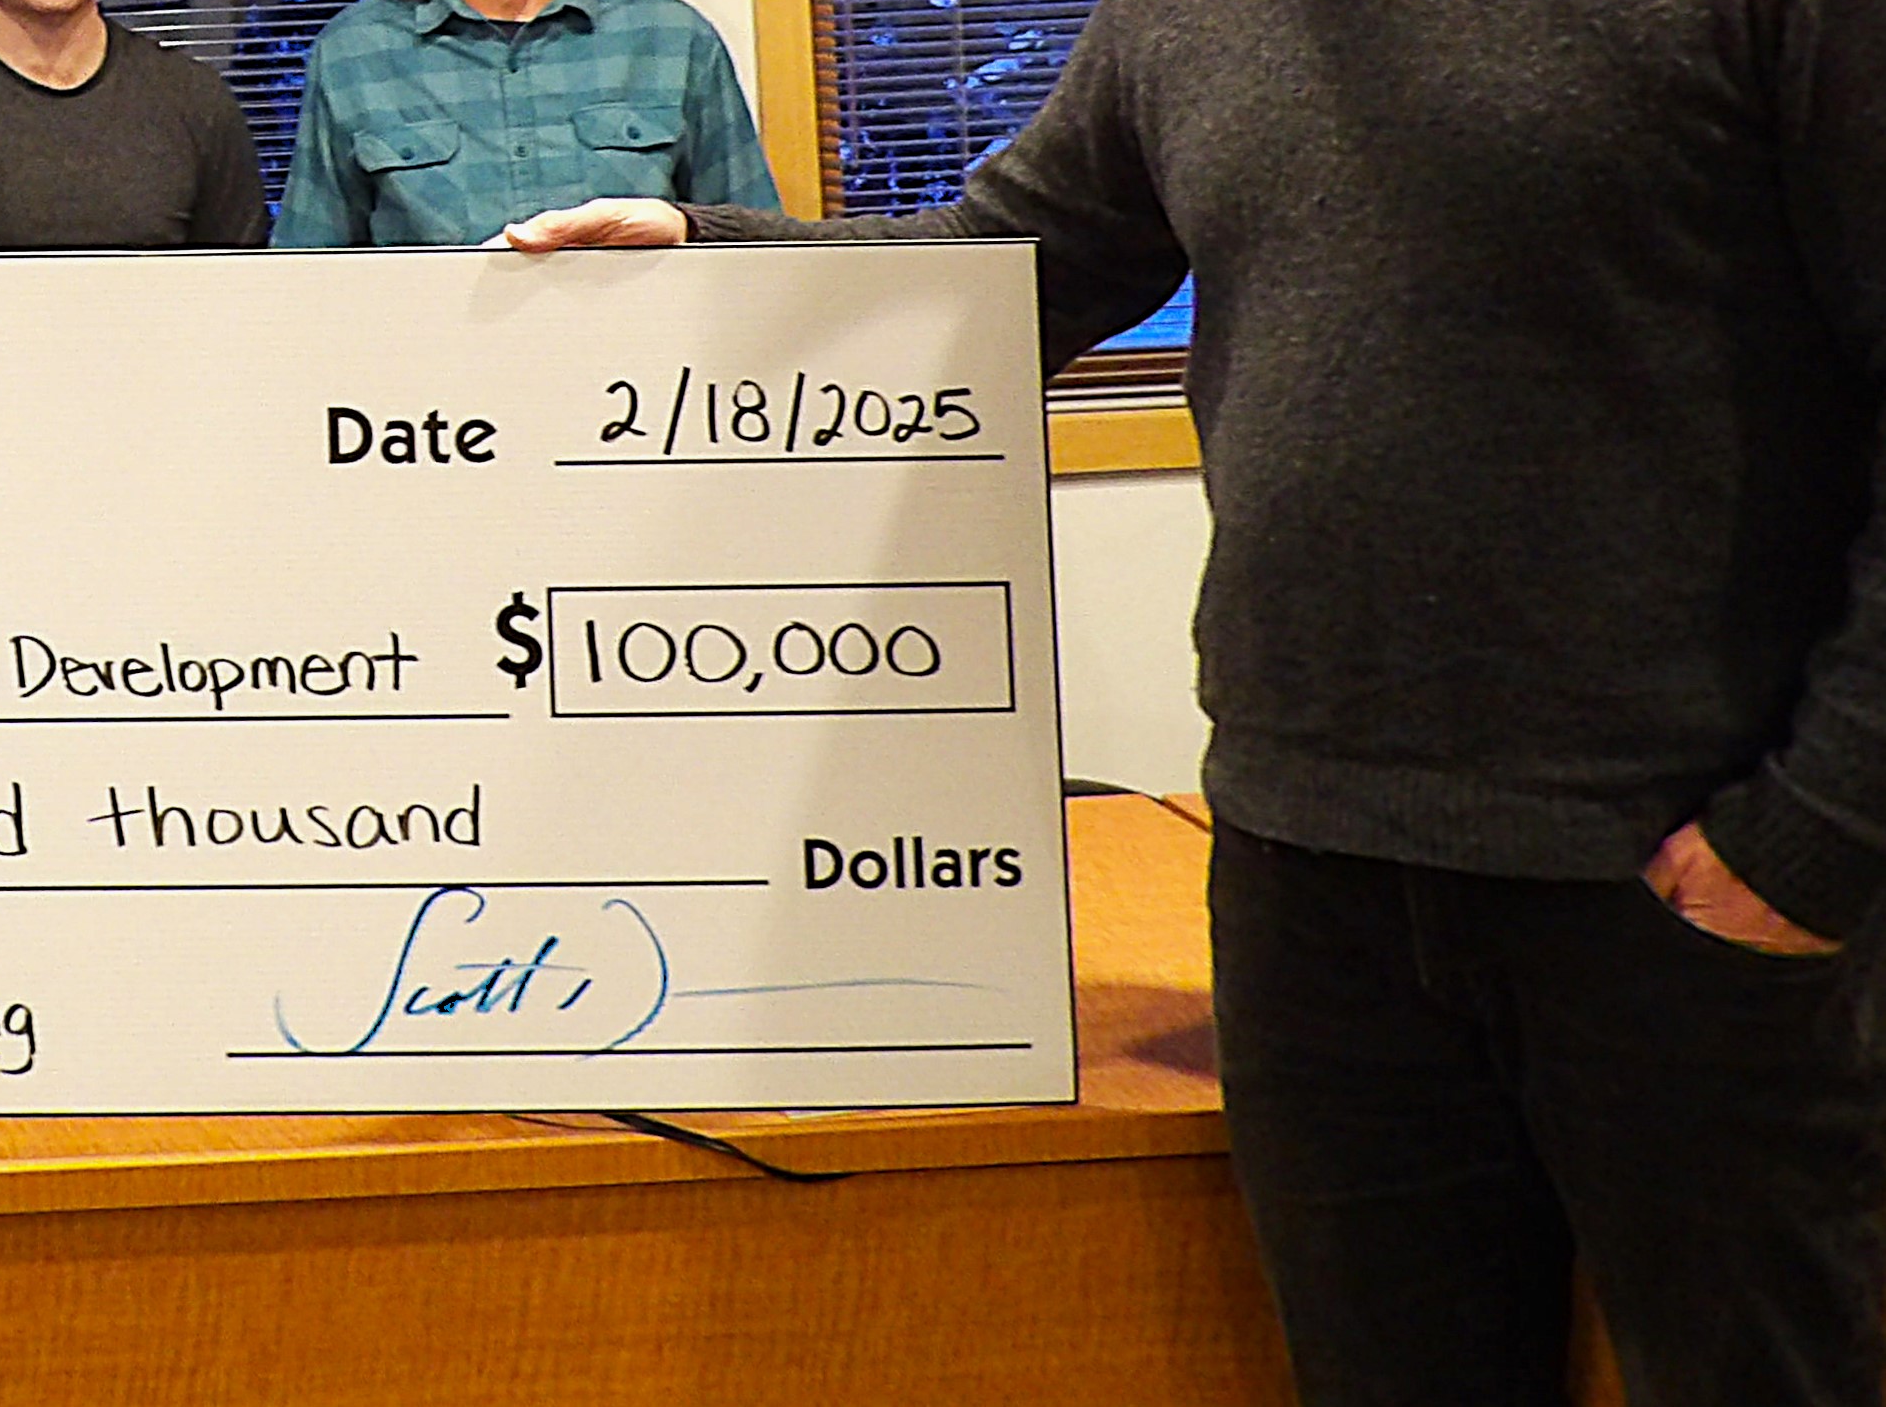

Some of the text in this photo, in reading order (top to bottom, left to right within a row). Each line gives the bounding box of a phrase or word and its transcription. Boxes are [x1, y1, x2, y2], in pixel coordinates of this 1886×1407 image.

[327, 407, 498, 465] Date
[599, 366, 982, 455] 2/18/2025
[9, 631, 420, 711] Development
[496, 591, 543, 690] $
[585, 619, 942, 693] 100,000
[88, 783, 482, 850] thousand
[803, 835, 1023, 890] Dollars
